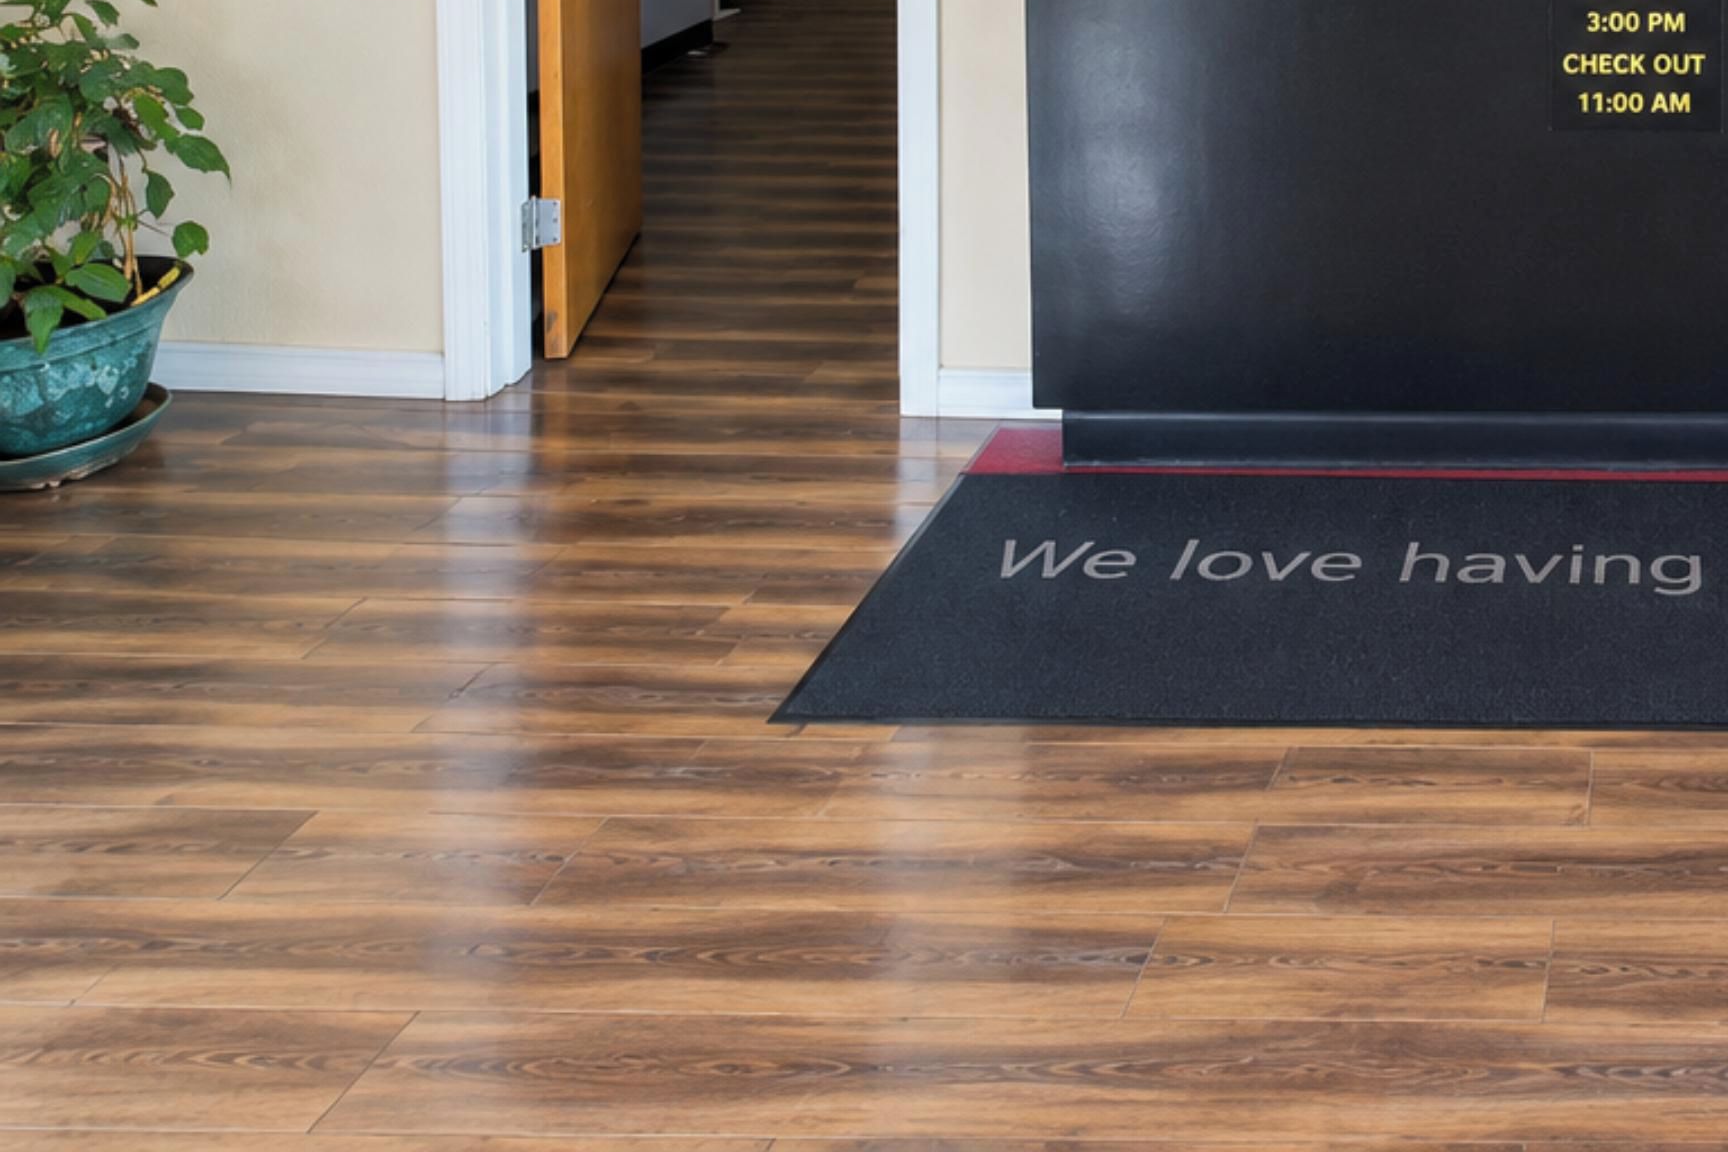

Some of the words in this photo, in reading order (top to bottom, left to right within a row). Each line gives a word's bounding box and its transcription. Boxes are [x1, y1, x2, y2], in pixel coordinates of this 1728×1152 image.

[1586, 11, 1640, 33] 3:00
[1647, 11, 1686, 33] PM
[1562, 52, 1647, 76] CHECK
[1652, 52, 1707, 76] OUT
[1577, 91, 1644, 114] 11:00
[1650, 91, 1692, 114] AM
[999, 538, 1138, 581] We
[1168, 538, 1364, 582] love
[1398, 541, 1702, 596] having
